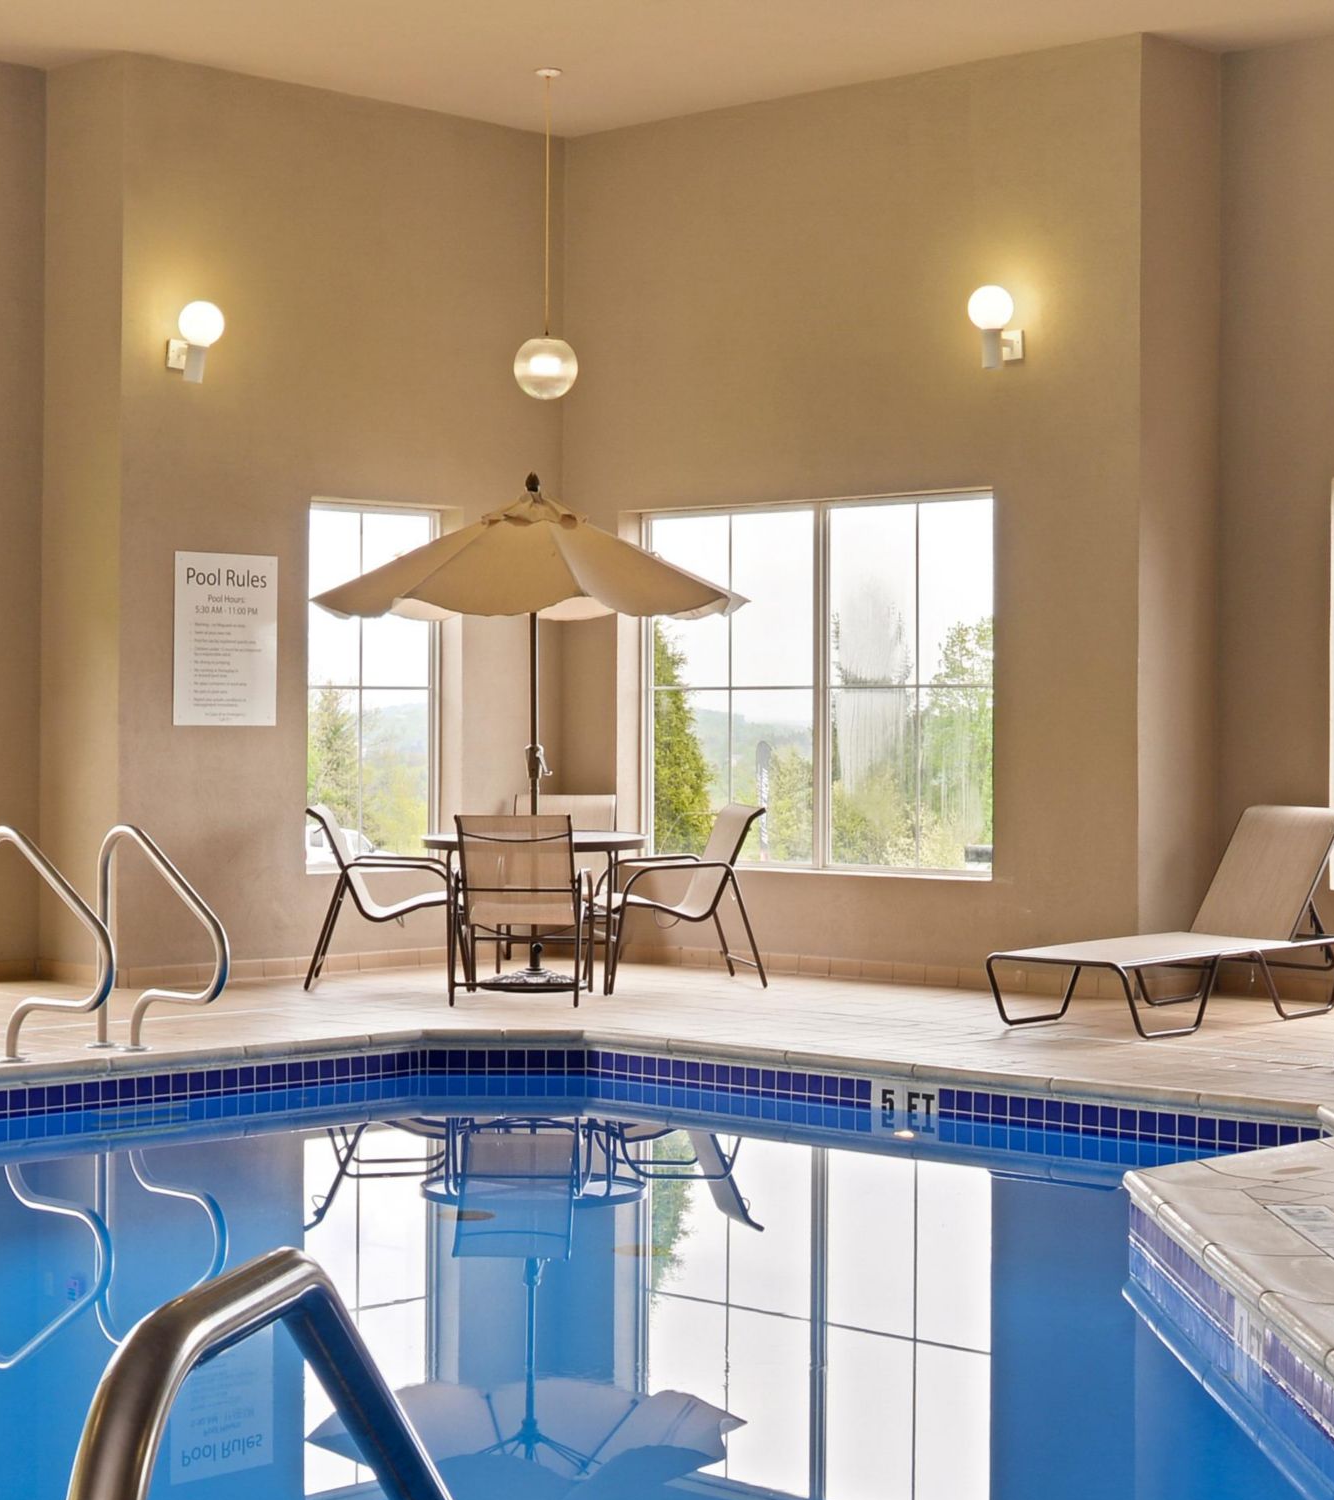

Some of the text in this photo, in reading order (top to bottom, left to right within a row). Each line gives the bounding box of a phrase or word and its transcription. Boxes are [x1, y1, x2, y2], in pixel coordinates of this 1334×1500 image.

[186, 567, 267, 588] Pool Rules
[208, 594, 223, 603] Pool
[881, 1089, 935, 1115] 5 FT
